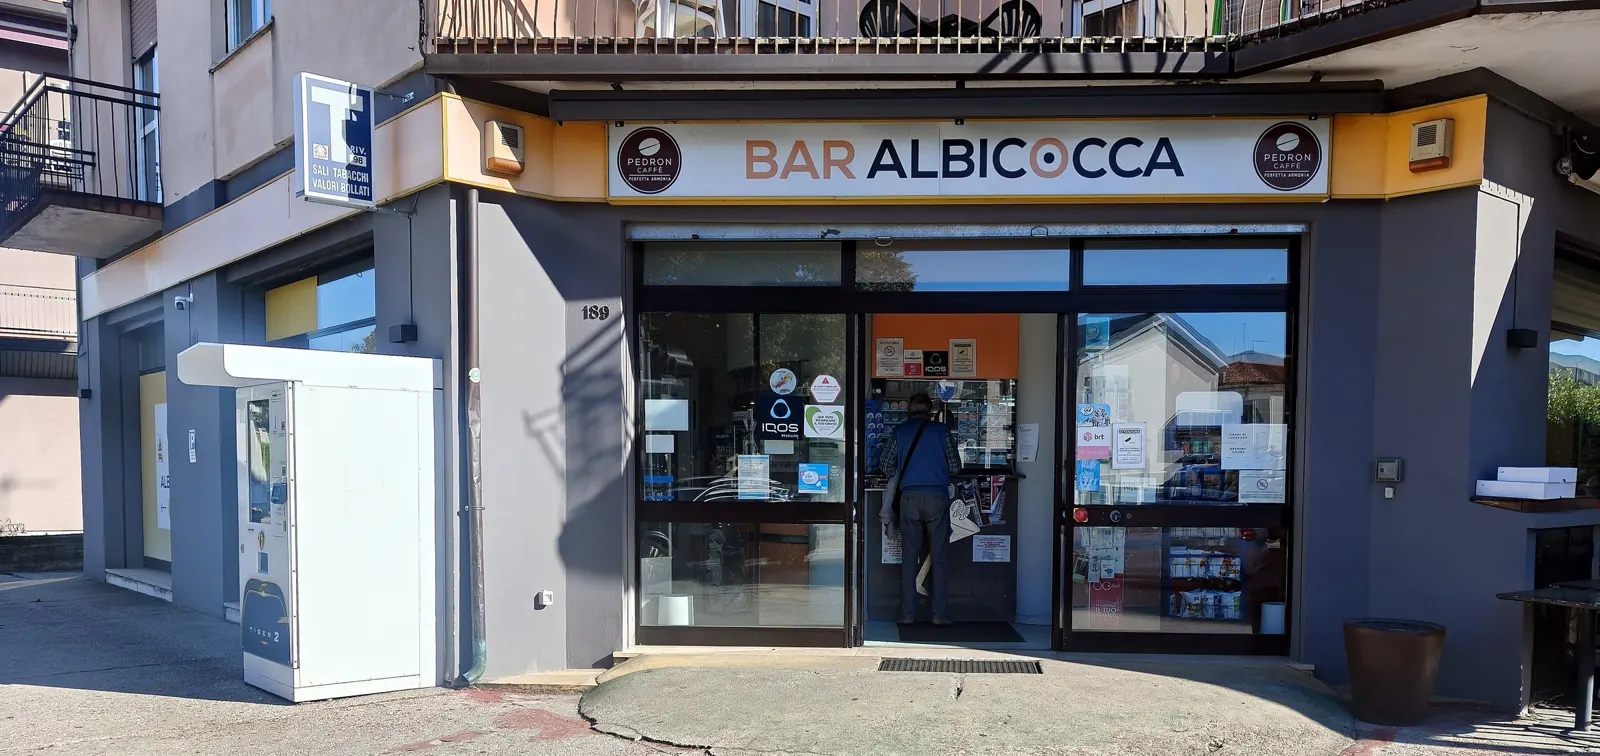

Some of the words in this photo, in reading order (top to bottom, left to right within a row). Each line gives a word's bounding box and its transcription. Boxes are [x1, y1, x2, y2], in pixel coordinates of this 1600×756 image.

[311, 86, 363, 163] T
[350, 145, 366, 155] RIV.
[352, 155, 363, 165] 98
[627, 158, 672, 166] PEDRON
[746, 140, 856, 179] BAR
[866, 137, 1184, 179] ALBICOCCA
[1264, 153, 1311, 161] PEDRON
[312, 164, 329, 176] SALI
[333, 167, 369, 183] TABACCHI
[312, 178, 339, 191] VALORI
[340, 181, 370, 197] BOLLATI
[581, 305, 610, 320] 189
[762, 423, 799, 434] IQOS
[273, 631, 280, 643] 2
